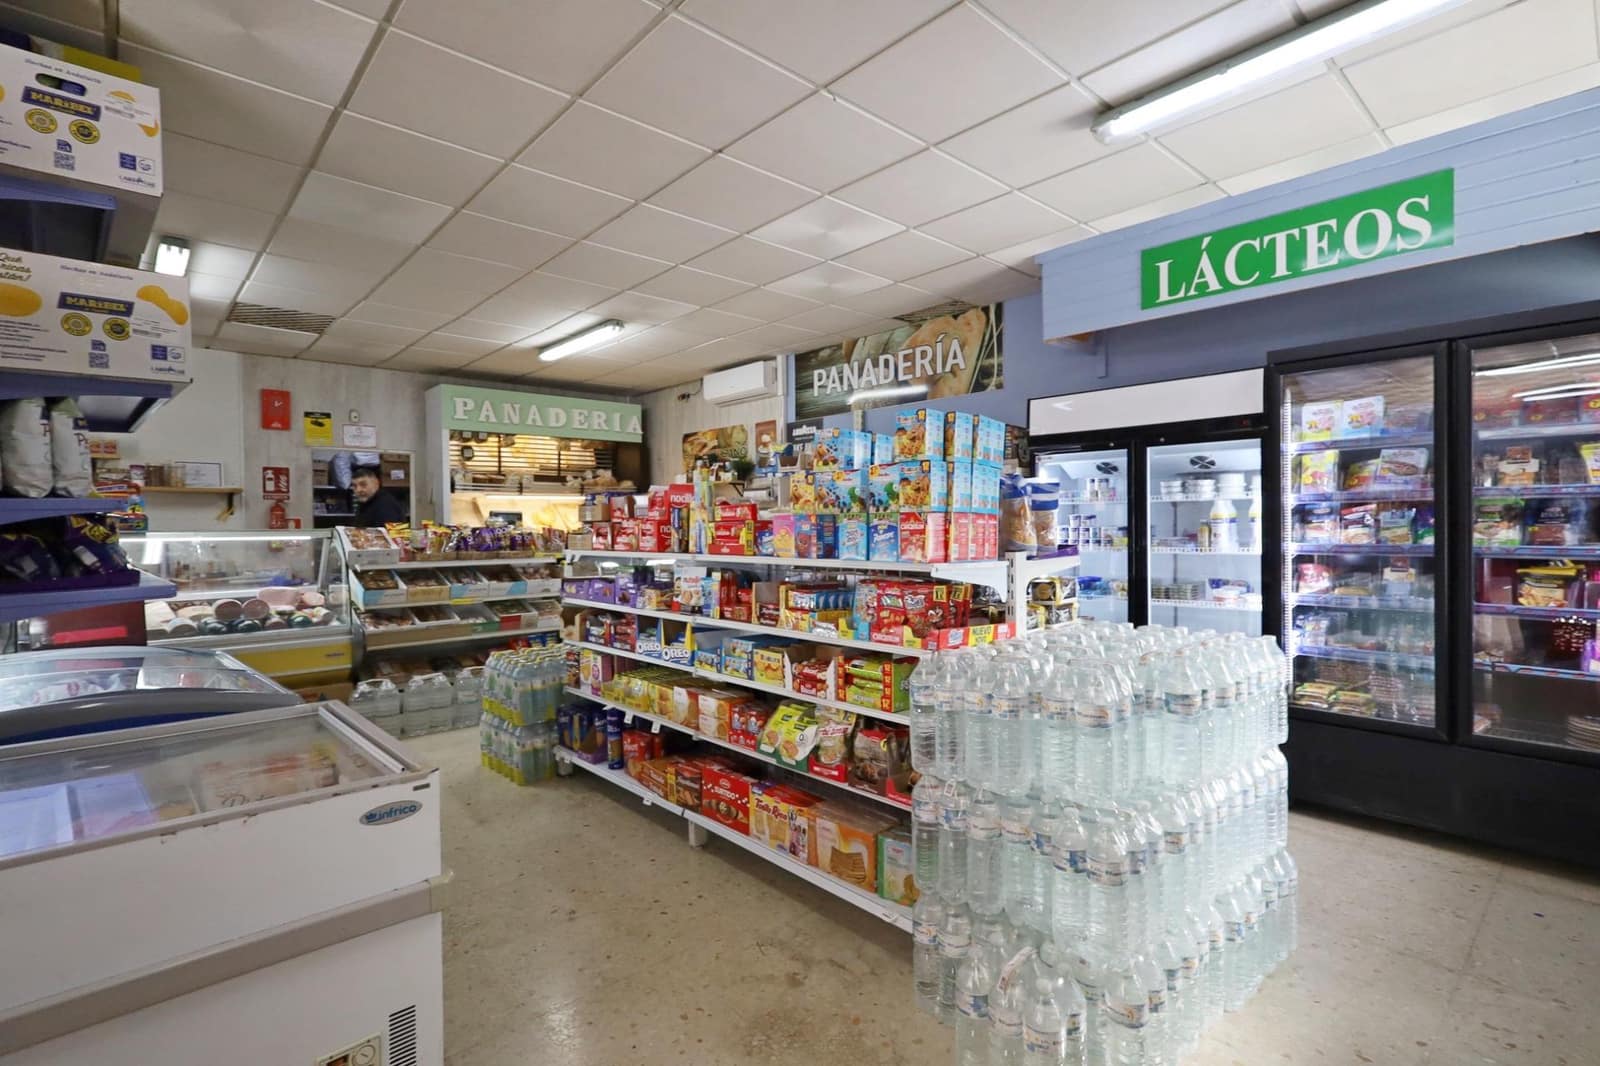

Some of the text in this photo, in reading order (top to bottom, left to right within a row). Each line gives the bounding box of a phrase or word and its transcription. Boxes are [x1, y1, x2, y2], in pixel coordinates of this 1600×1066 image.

[1155, 195, 1432, 303] LÁCTEOS
[813, 333, 966, 397] PANADERÍA
[453, 397, 643, 434] PANADERIA
[636, 642, 661, 653] OREO
[662, 648, 690, 661] OREO
[376, 804, 417, 820] infrico
